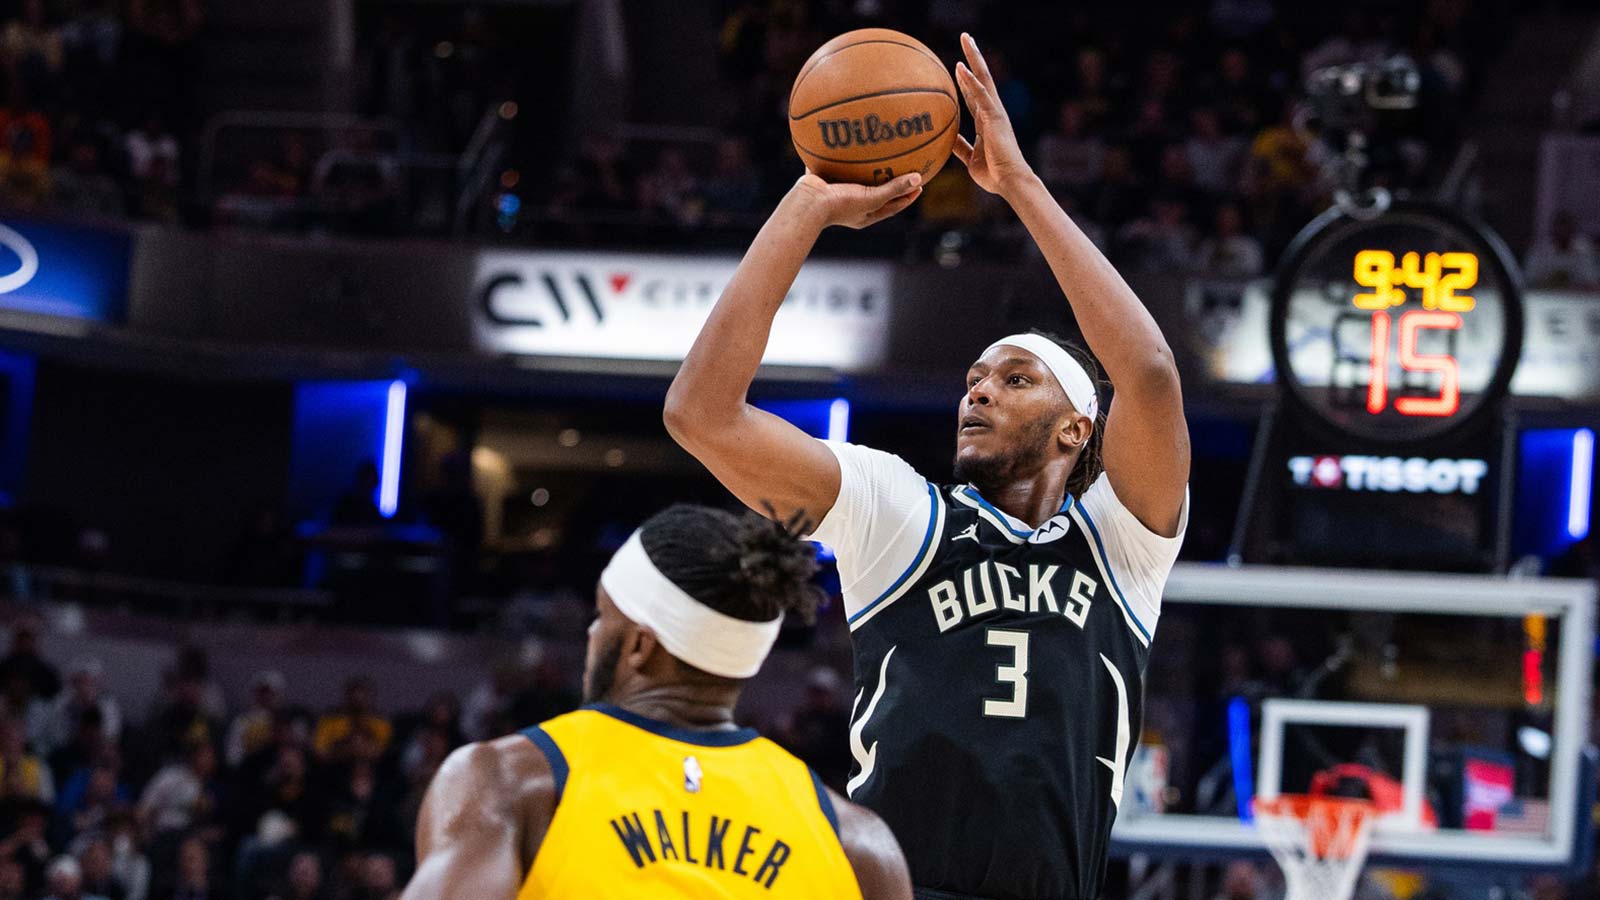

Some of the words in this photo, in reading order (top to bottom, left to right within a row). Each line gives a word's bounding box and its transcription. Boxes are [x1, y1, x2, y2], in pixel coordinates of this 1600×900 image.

[818, 111, 934, 149] Wilson
[1353, 249, 1479, 312] 9:42
[1367, 311, 1462, 416] 15
[1339, 455, 1488, 494] TISSOT
[928, 560, 1097, 633] BUCKS
[982, 628, 1030, 719] 3
[610, 809, 791, 889] WALKER
